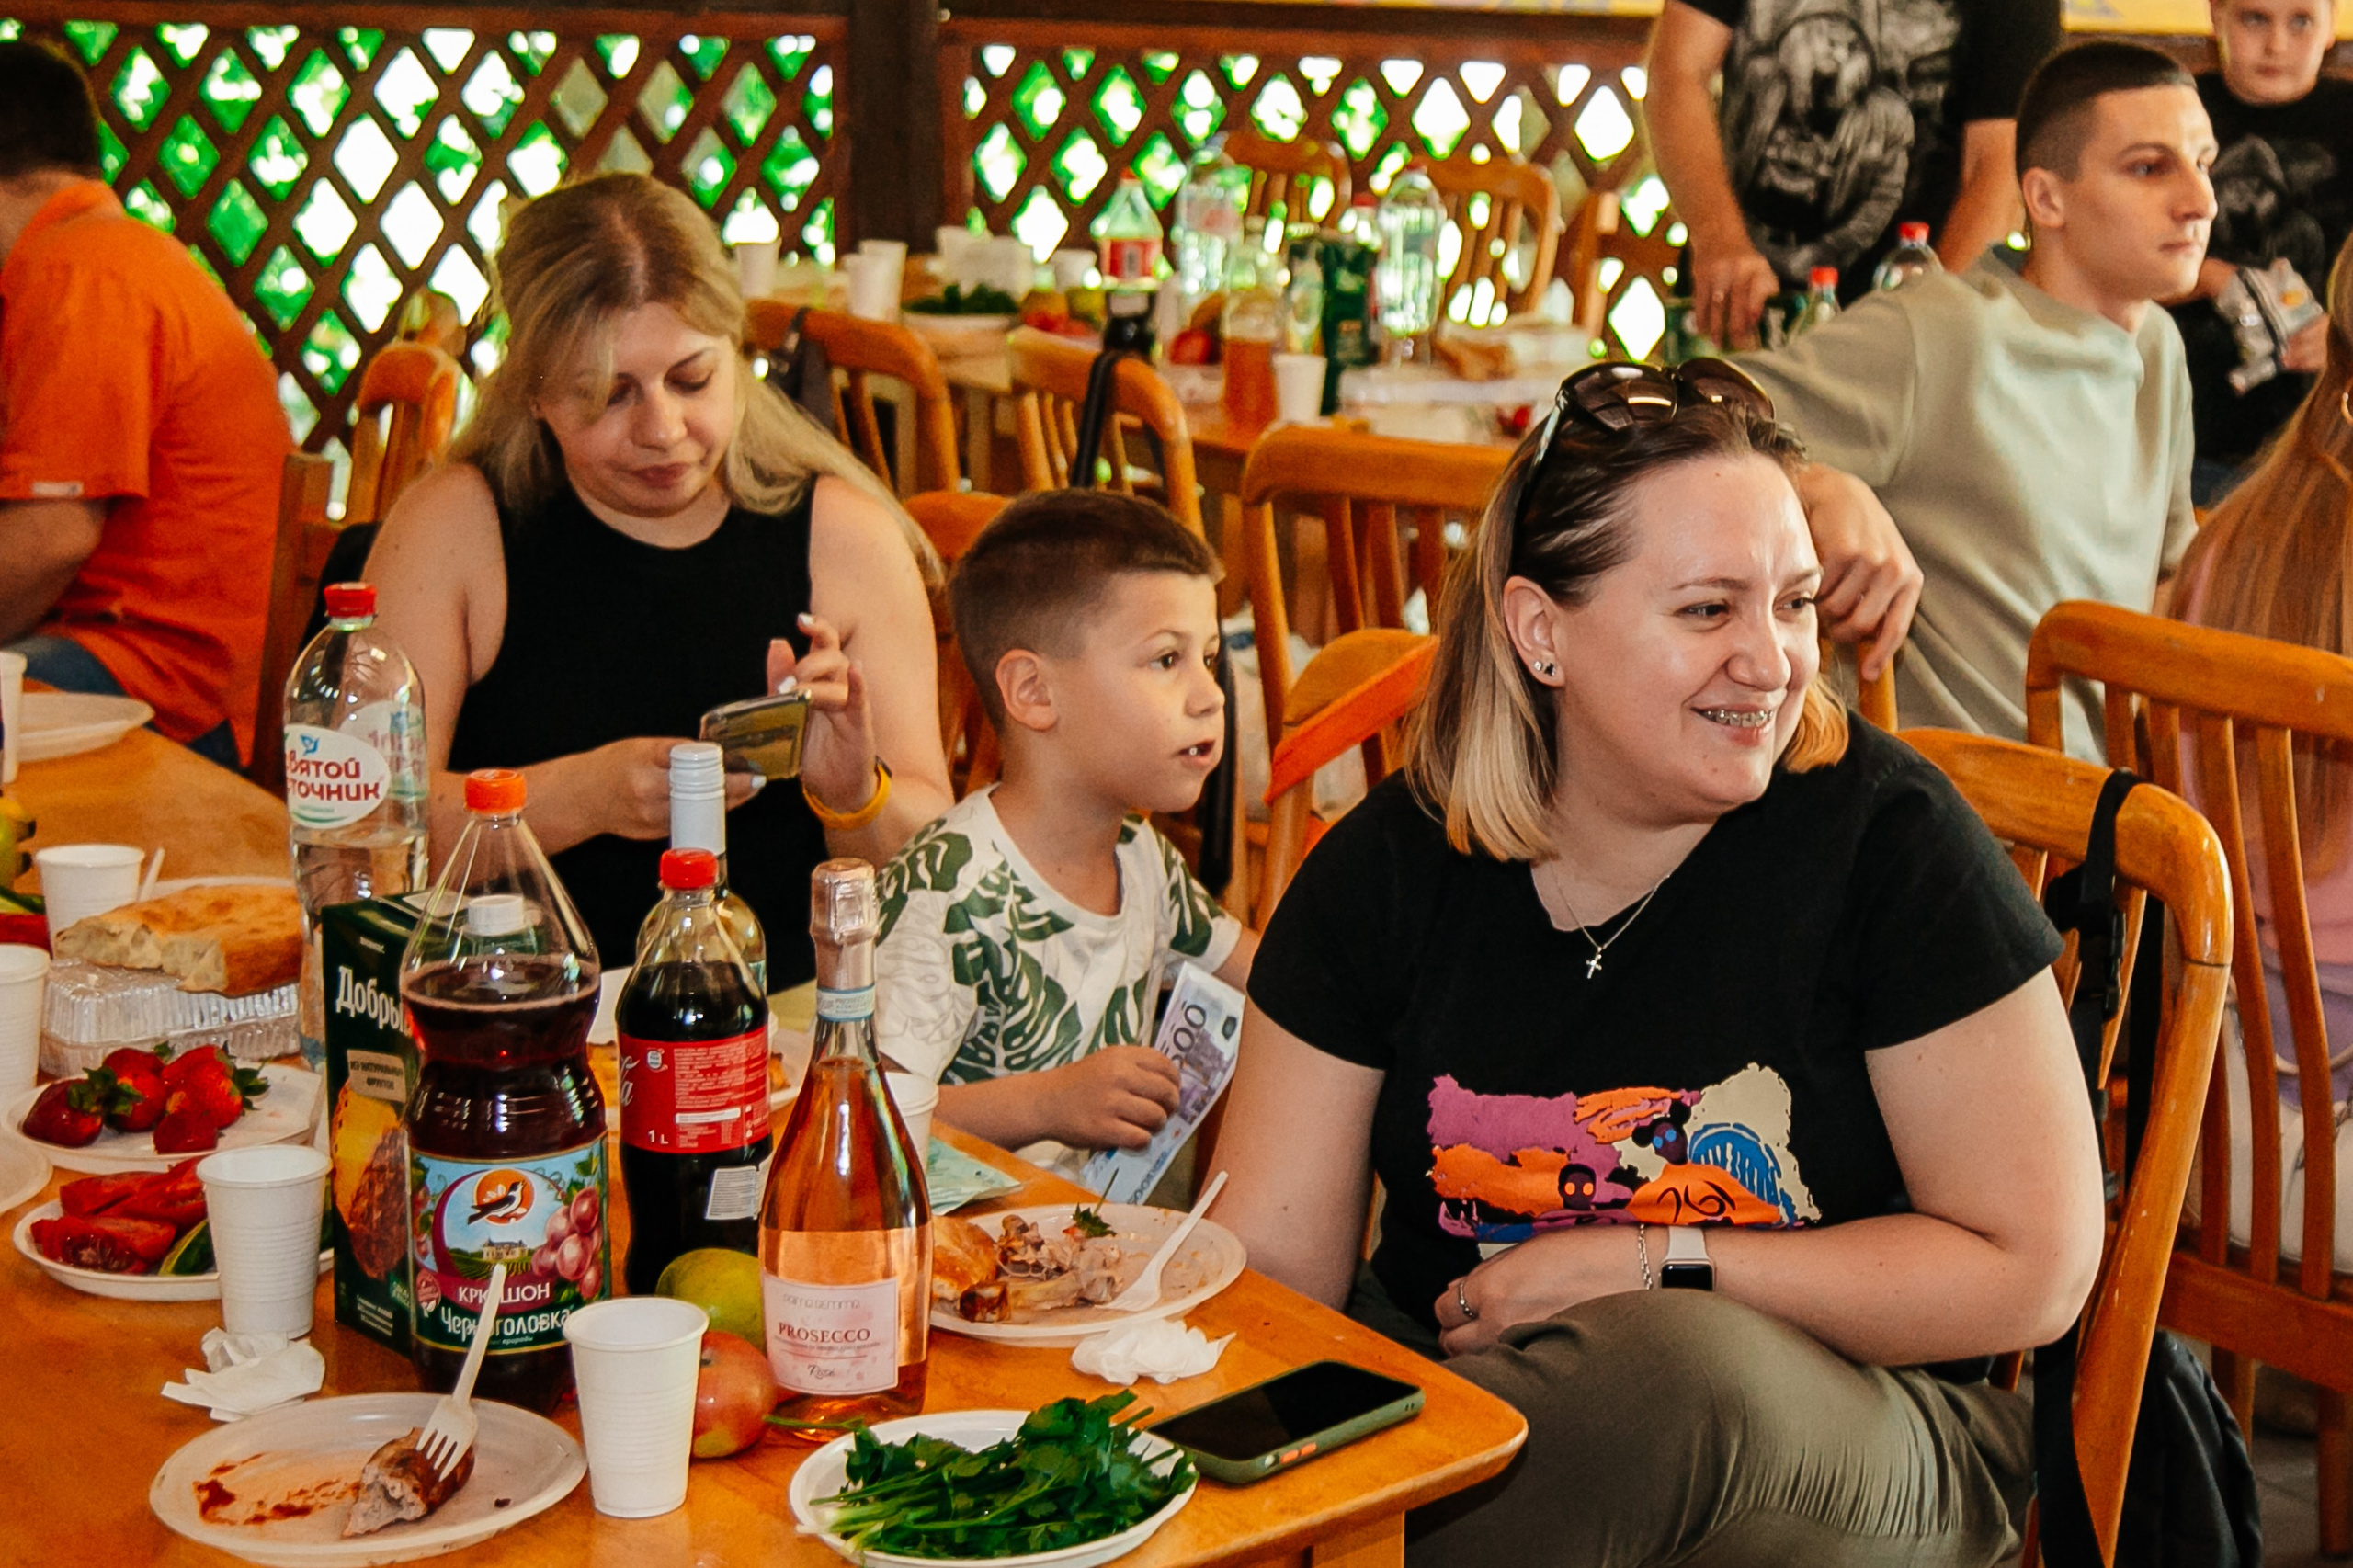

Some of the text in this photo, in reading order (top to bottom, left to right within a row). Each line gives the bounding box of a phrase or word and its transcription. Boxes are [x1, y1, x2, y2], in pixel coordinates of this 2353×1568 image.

[286, 749, 360, 779] вятой
[335, 966, 411, 1037] Добры
[649, 1130, 655, 1142] 1
[660, 1134, 669, 1145] L
[441, 1306, 571, 1342] Чернголовка
[779, 1323, 870, 1343] PROSECCO
